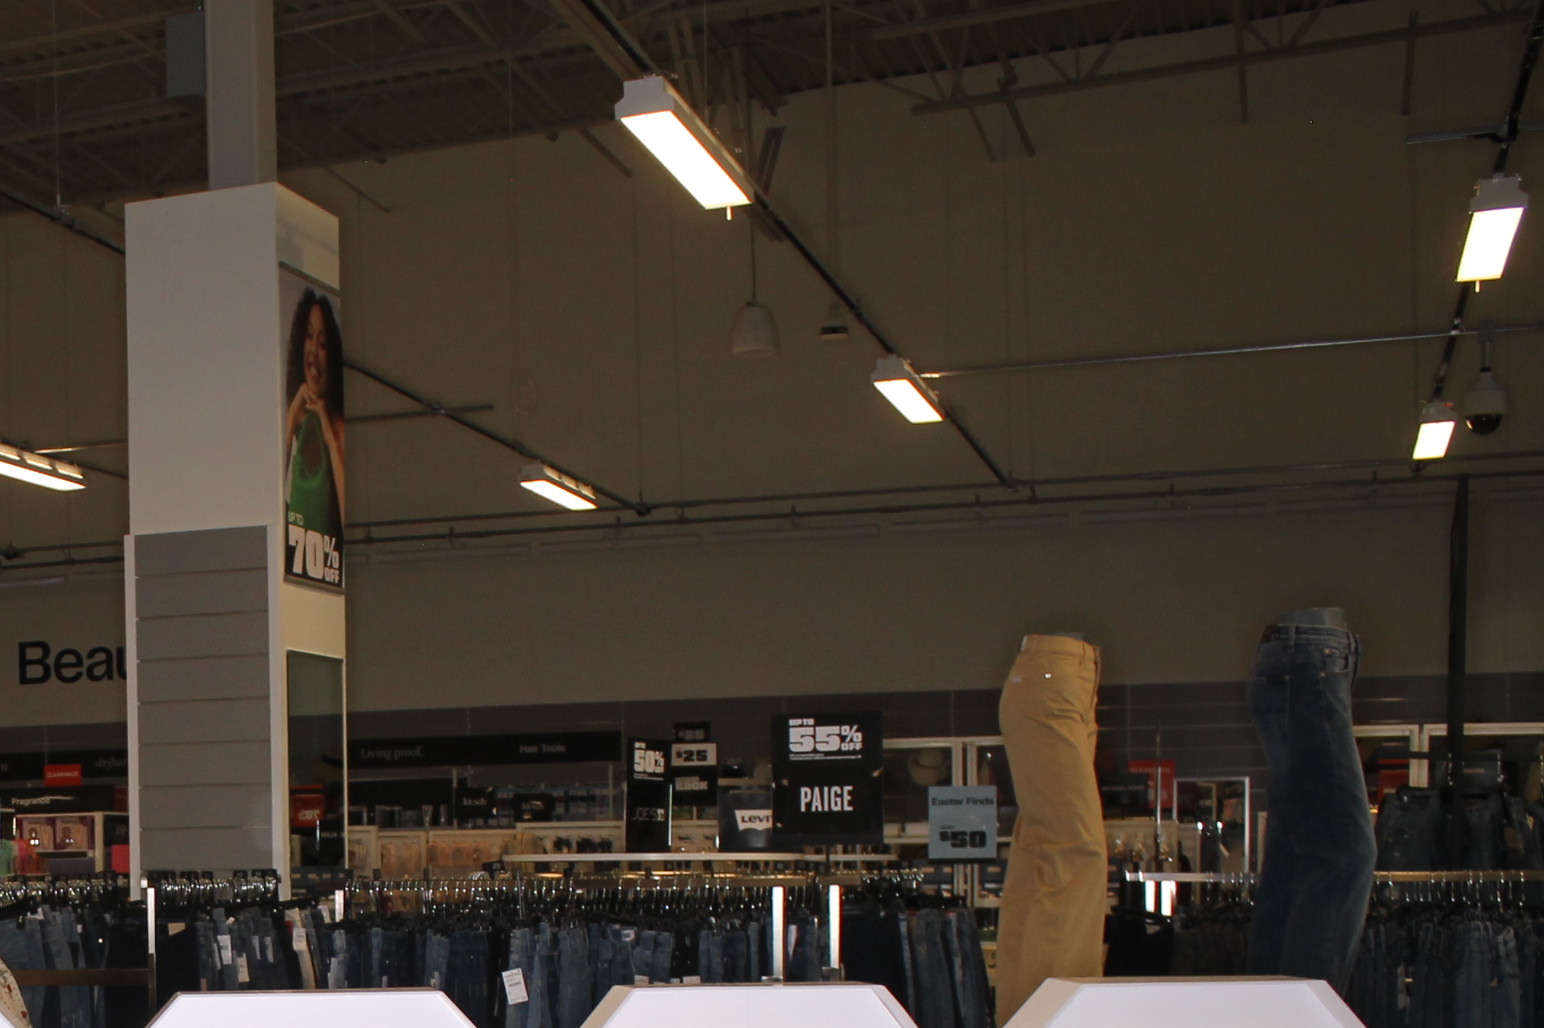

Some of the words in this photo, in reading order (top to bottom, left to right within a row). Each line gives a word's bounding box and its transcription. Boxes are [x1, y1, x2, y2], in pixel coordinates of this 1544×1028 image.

[288, 523, 340, 580] 70%
[324, 566, 340, 584] OFF
[18, 640, 127, 685] Bea
[789, 725, 862, 752] 55%
[841, 742, 862, 751] OFF
[800, 786, 854, 812] PAIGE
[931, 796, 964, 806] Easter
[966, 796, 995, 806] Finds
[939, 830, 987, 849] $50
